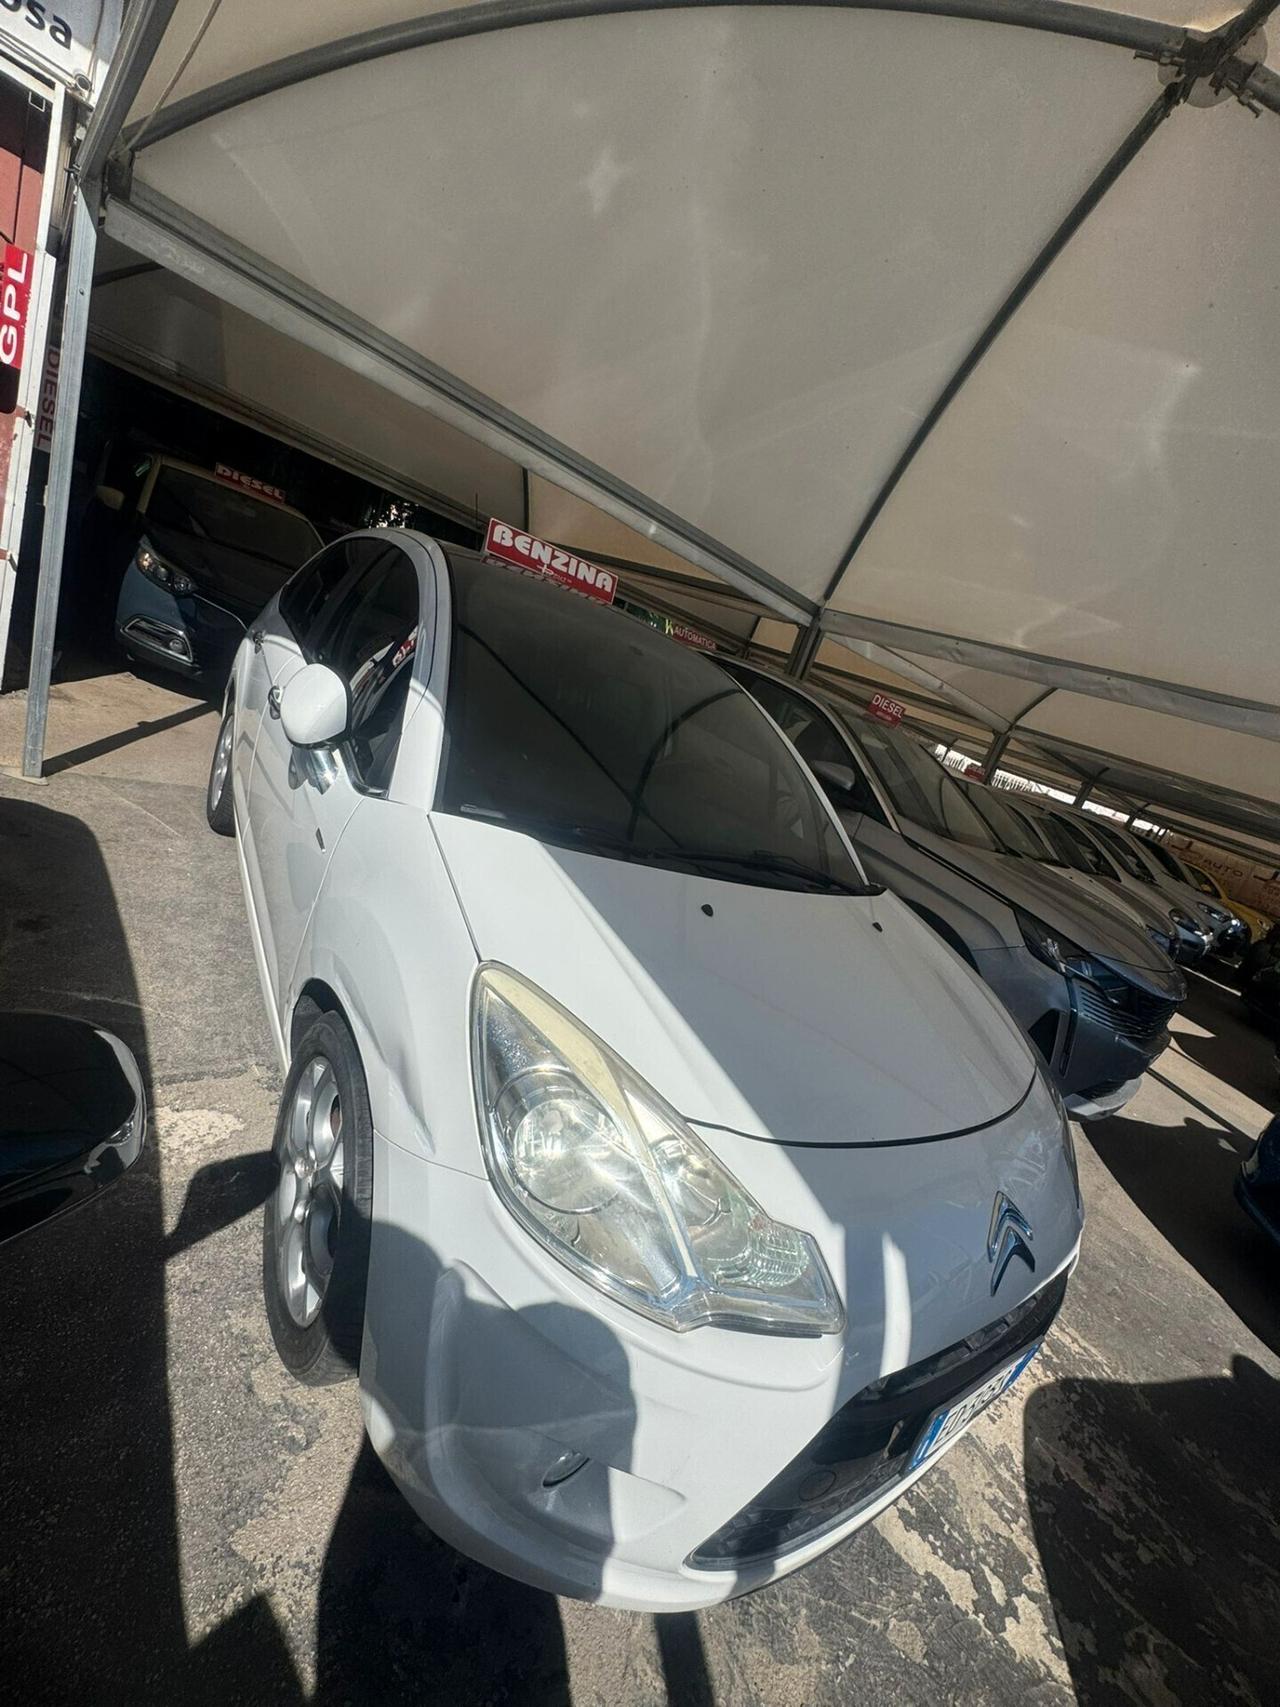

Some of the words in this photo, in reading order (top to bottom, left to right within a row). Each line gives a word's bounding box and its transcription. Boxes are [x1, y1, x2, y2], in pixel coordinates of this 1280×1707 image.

[0, 253, 28, 364] GPL
[37, 347, 60, 448] DIESEL
[217, 463, 283, 500] DIESEL
[493, 524, 613, 592] BENZINA
[872, 694, 904, 718] DIESEL
